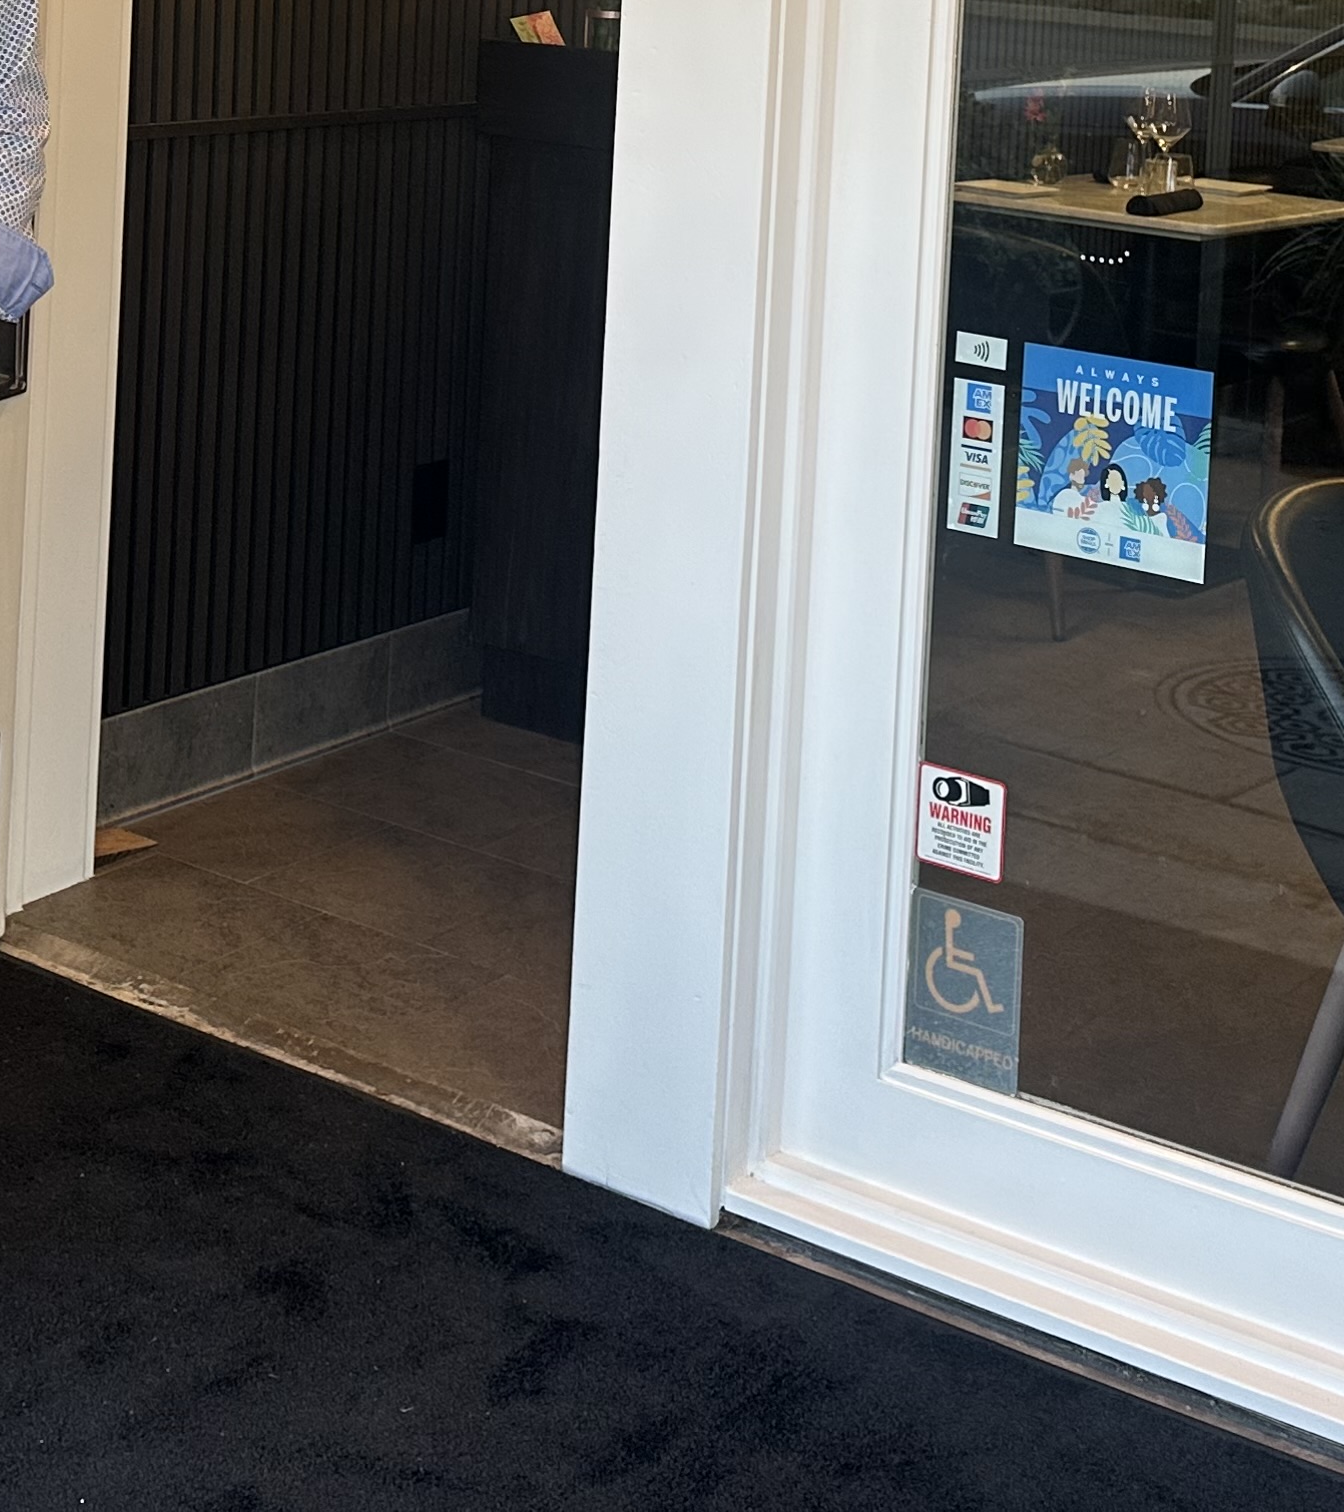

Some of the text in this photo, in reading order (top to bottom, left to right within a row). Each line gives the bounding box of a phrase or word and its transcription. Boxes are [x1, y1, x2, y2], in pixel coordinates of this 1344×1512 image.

[1076, 364, 1159, 387] ALWAYS
[1056, 377, 1178, 433] WELCOME
[964, 451, 989, 465] VISA
[929, 801, 992, 834] WARNING
[910, 1026, 1013, 1070] HANDICAPPED
